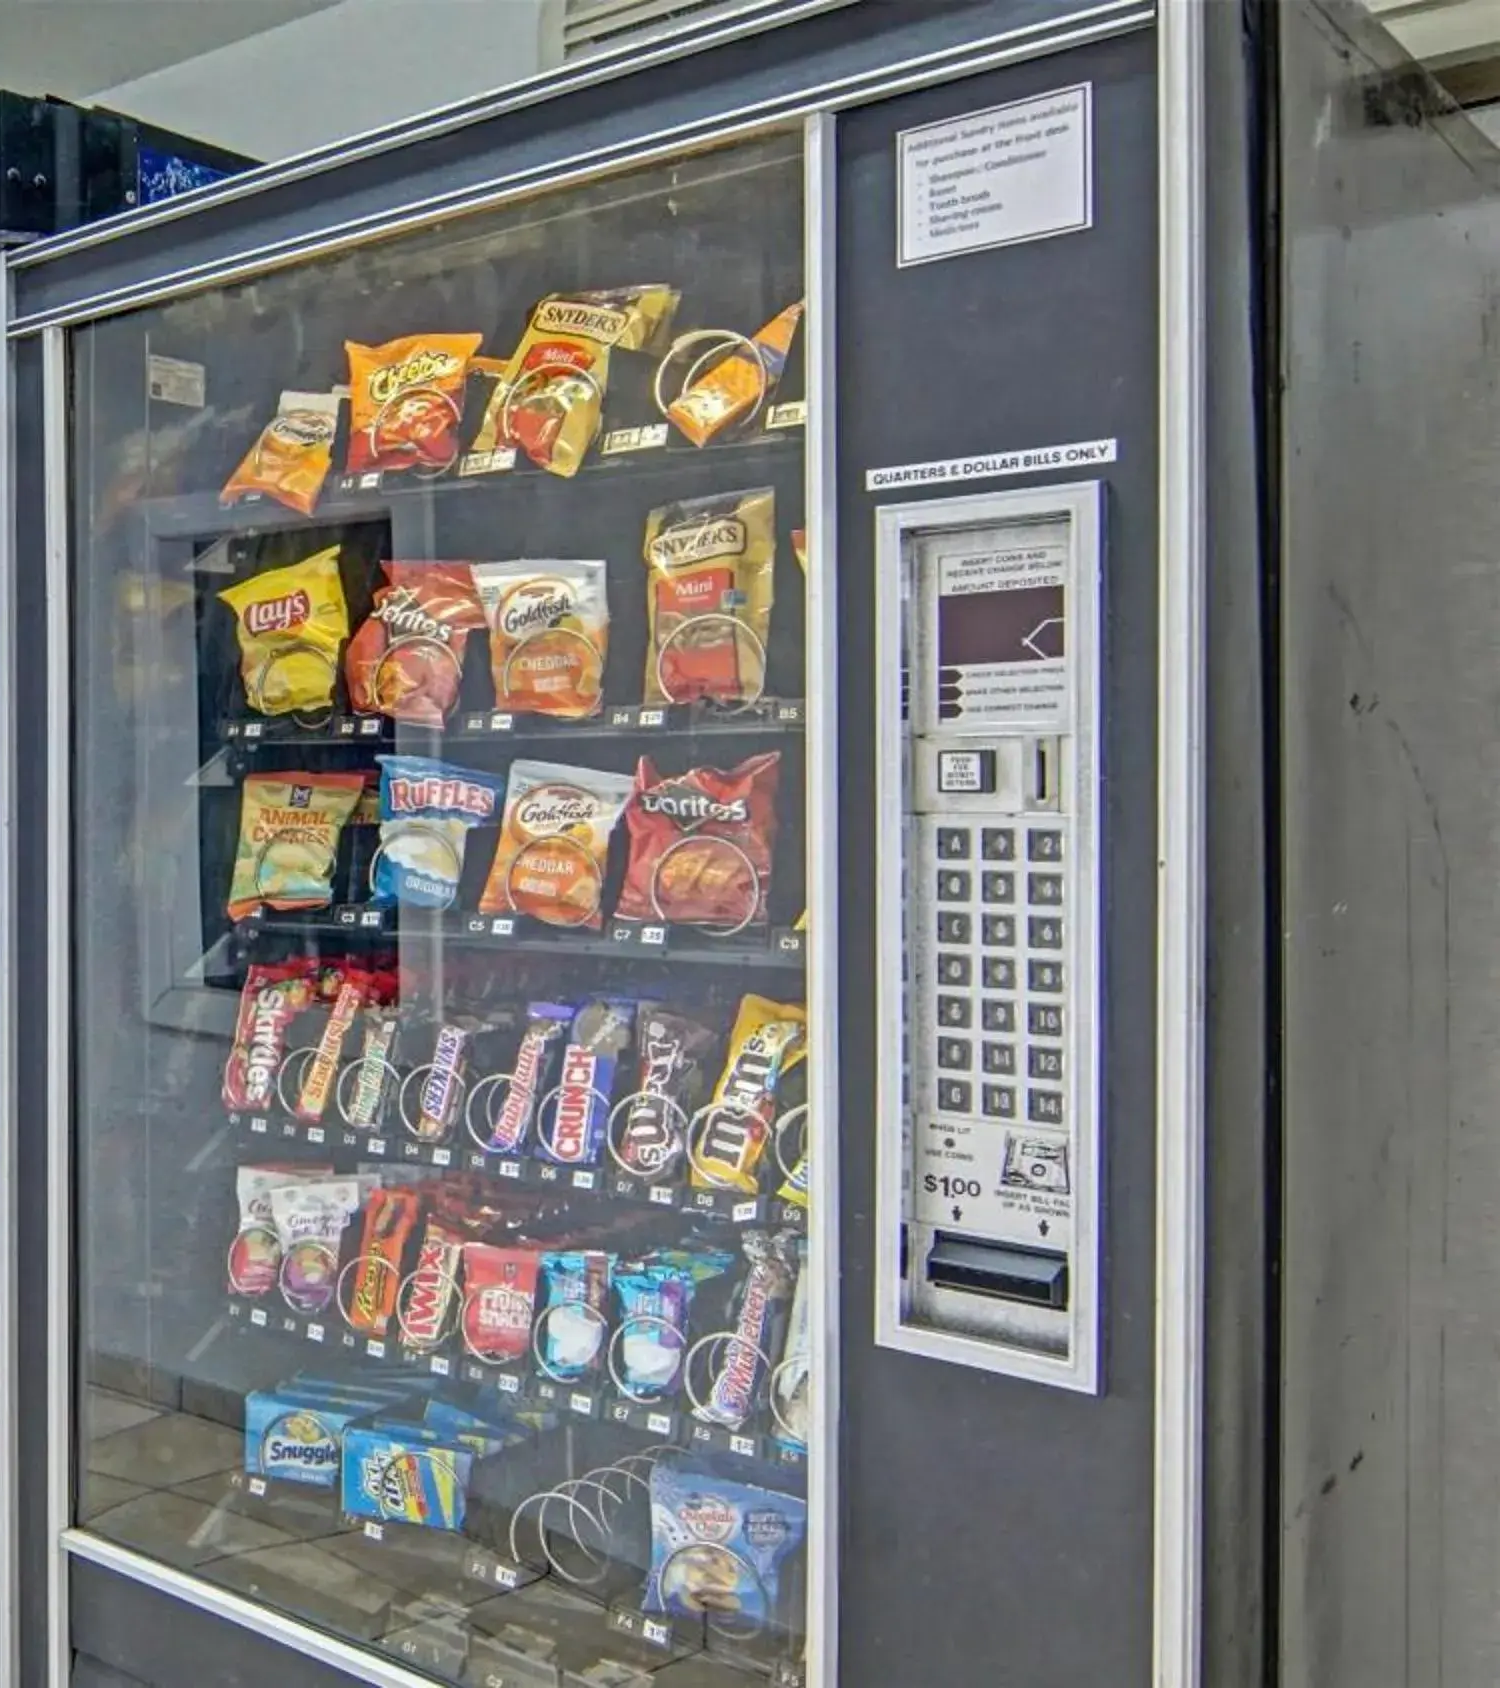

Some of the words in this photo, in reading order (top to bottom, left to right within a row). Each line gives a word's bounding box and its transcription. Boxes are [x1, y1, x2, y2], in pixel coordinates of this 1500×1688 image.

[544, 306, 622, 334] SNYDER'S
[368, 350, 460, 403] Cheetos
[873, 467, 947, 486] QUARTERS
[963, 457, 1019, 475] DOLLAR
[1023, 452, 1061, 467] BILLS
[1065, 445, 1109, 462] ONLY
[675, 578, 714, 597] Mini
[951, 581, 995, 593] AMOUNT
[997, 575, 1059, 589] DEPOSITED
[249, 590, 306, 632] Lay's
[505, 594, 572, 633] Goldfish
[389, 776, 496, 816] RUFFLES
[641, 793, 749, 821] Doritos
[259, 806, 332, 826] ANIMAL
[519, 801, 594, 824] Goldfish
[1043, 837, 1053, 855] 2
[245, 987, 285, 1102] Skittles
[1039, 1053, 1058, 1070] 12
[554, 1044, 596, 1160] CRUNCH
[1039, 1095, 1058, 1114] 14
[924, 1173, 982, 1199] $1.00
[403, 1239, 447, 1344] TWIX
[269, 1441, 339, 1464] Snuggle
